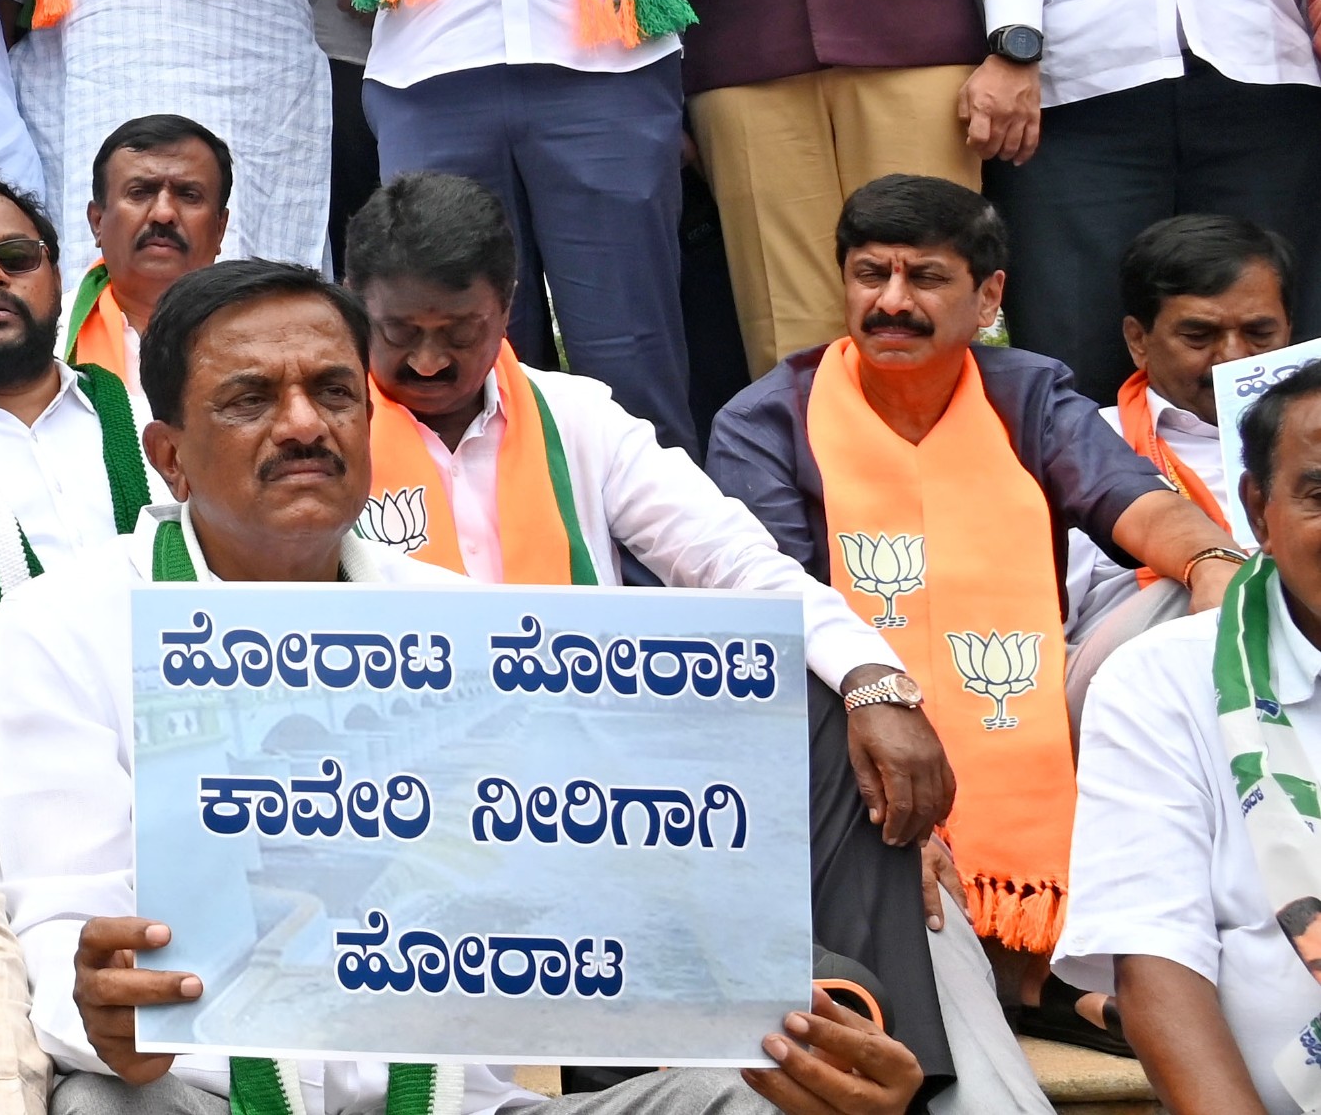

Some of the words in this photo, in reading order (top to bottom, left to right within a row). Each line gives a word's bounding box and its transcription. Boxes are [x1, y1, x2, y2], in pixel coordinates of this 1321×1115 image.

[160, 611, 453, 690] ಹೋರಾಟ
[489, 614, 777, 701] ಹೋರಾಟ
[199, 757, 432, 840] ಕಾವೇರಿ
[471, 776, 748, 849] ನೀರಿಗಾಗಿ
[333, 910, 625, 997] ಹೋರಾಟ
